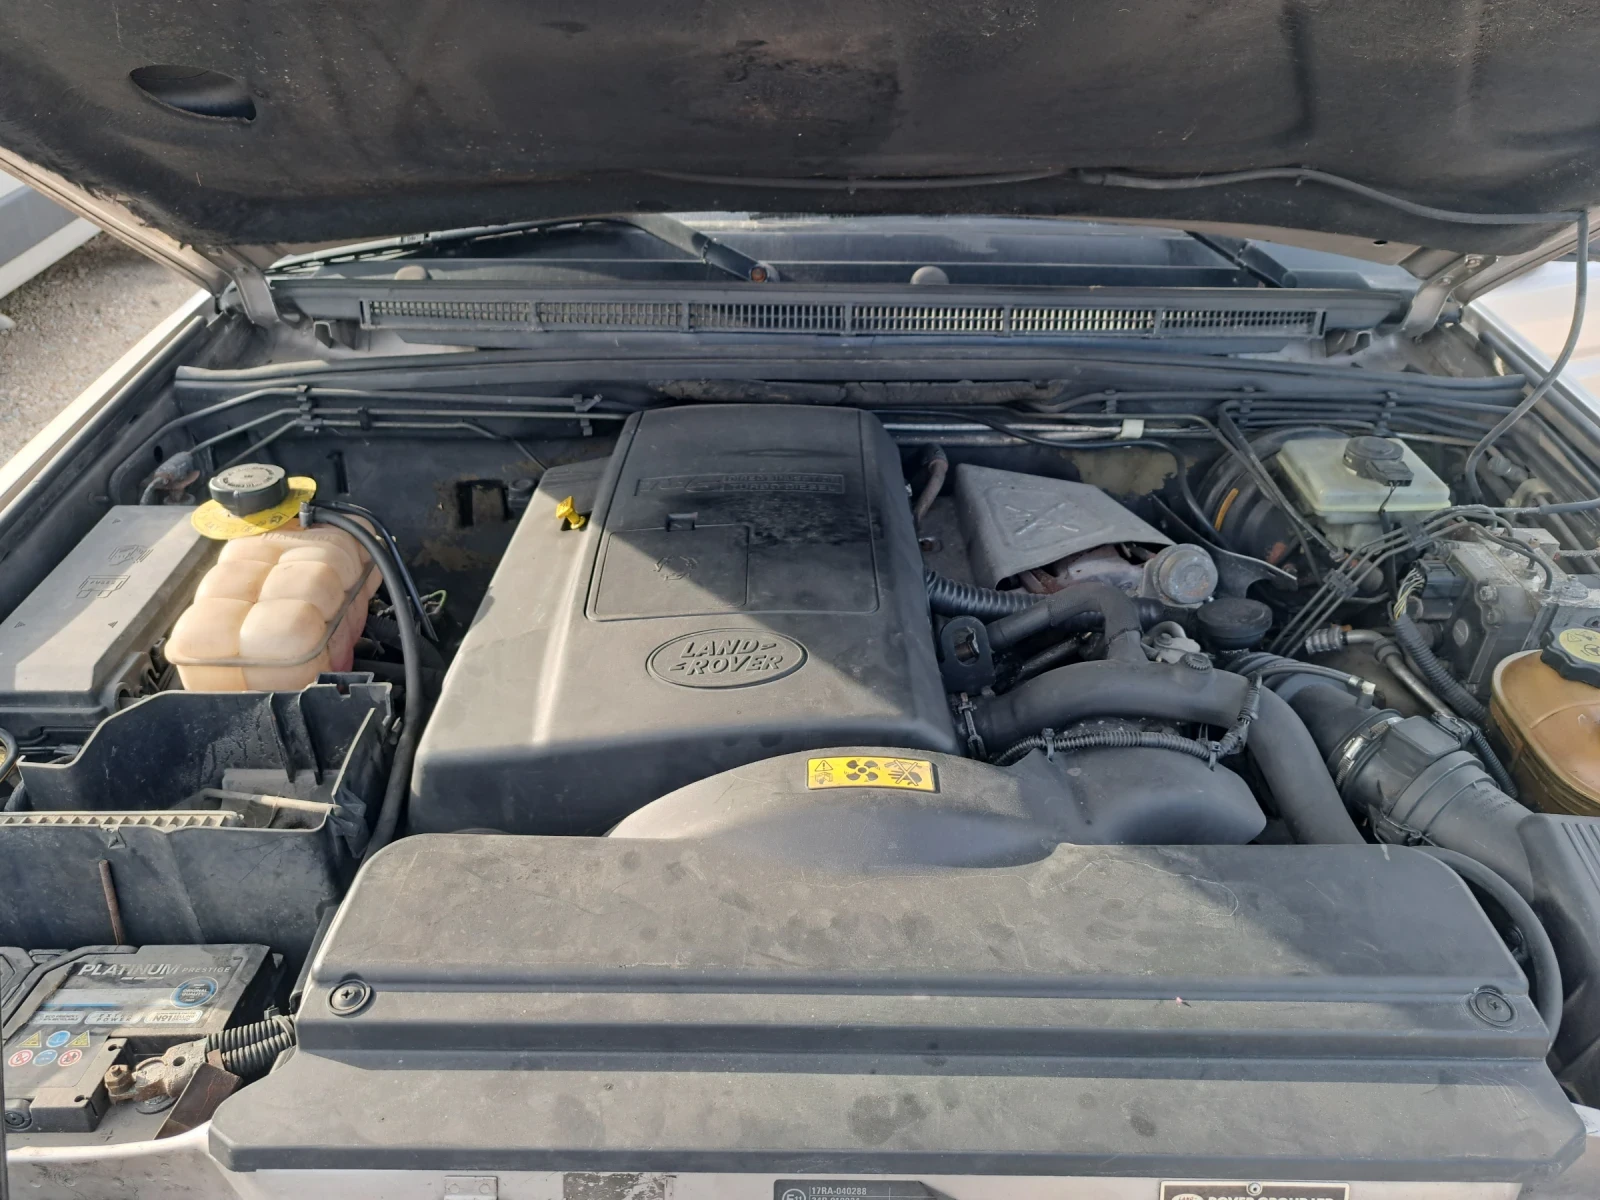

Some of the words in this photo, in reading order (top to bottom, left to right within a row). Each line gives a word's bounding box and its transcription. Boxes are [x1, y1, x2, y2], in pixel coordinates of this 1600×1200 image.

[680, 639, 760, 658] LAND
[686, 654, 784, 676] ROVER
[77, 963, 182, 976] PLATINUM
[811, 1187, 867, 1195] 17RA-040288
